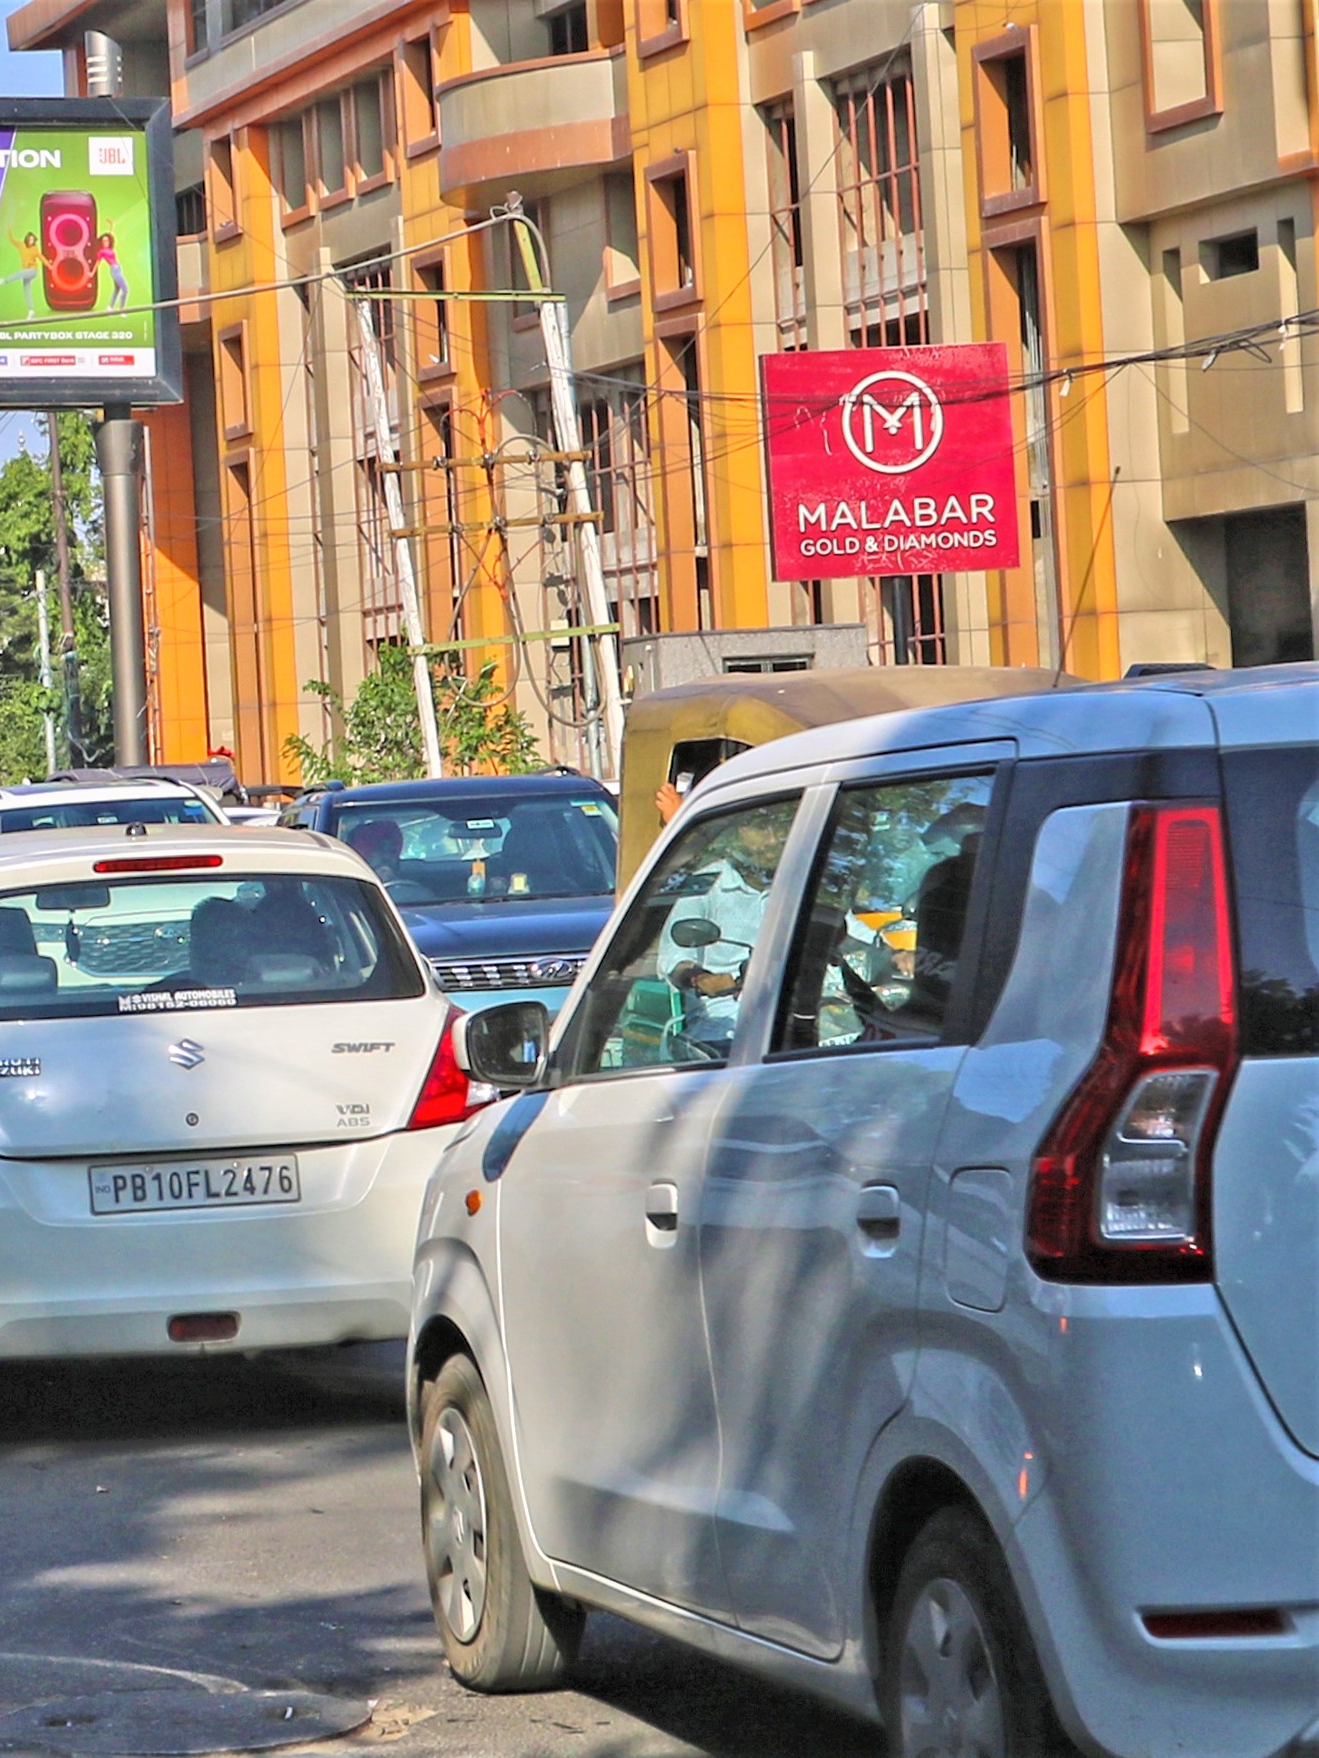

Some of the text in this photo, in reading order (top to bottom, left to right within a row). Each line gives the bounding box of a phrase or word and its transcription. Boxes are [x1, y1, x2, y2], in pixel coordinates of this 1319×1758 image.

[98, 147, 126, 165] JBL
[13, 330, 72, 341] PARTYBOX
[75, 330, 109, 340] STAGE
[797, 493, 995, 533] MALABAR
[799, 529, 997, 557] GOLD & DIAMONDS
[174, 988, 236, 1002] AUTOMOBILES
[330, 1042, 396, 1054] SWIFT
[336, 1116, 371, 1128] ABS
[112, 1165, 293, 1204] PB10FL2476
